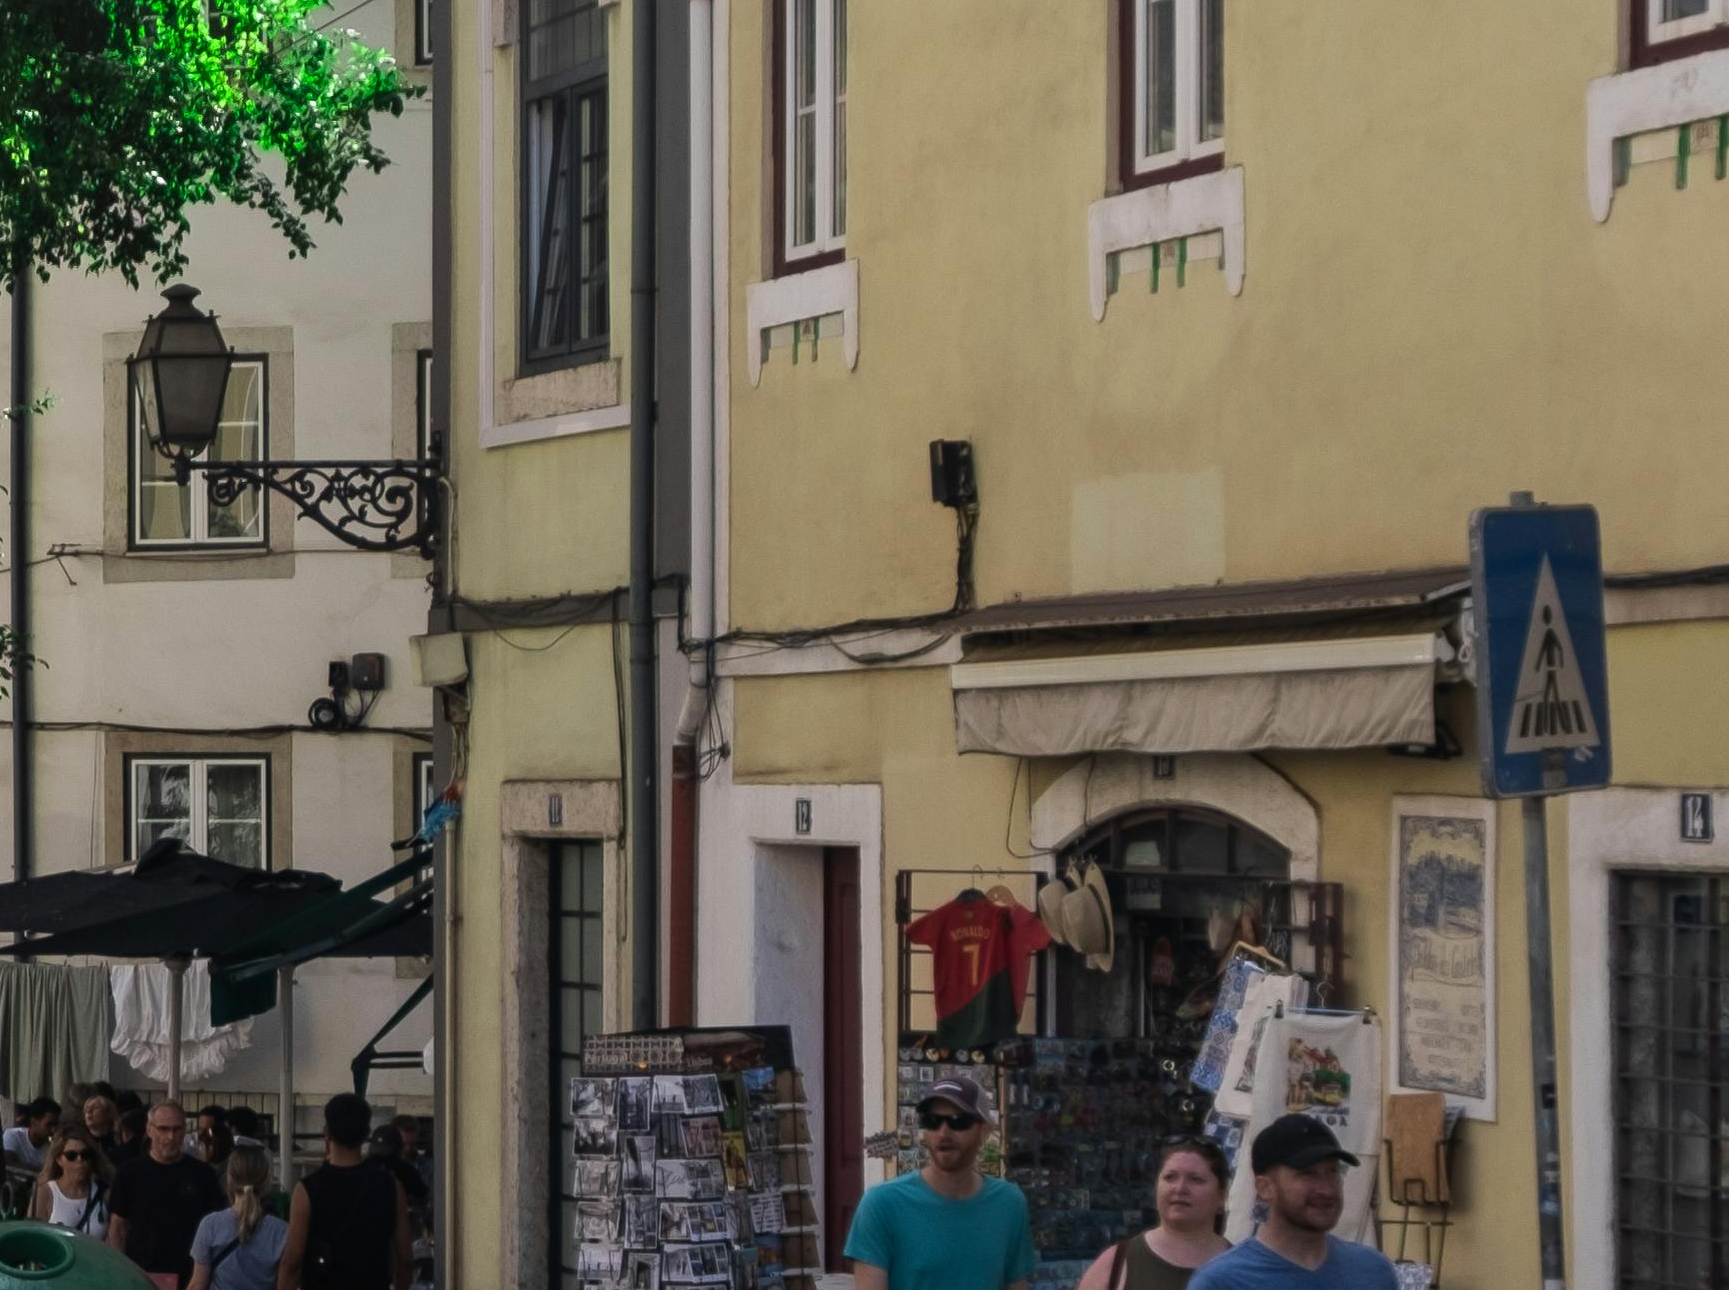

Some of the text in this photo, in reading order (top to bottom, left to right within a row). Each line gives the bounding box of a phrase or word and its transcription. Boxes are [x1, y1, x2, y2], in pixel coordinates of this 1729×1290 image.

[1687, 797, 1704, 838] 14
[950, 925, 991, 943] RONALDO
[962, 943, 980, 986] 7
